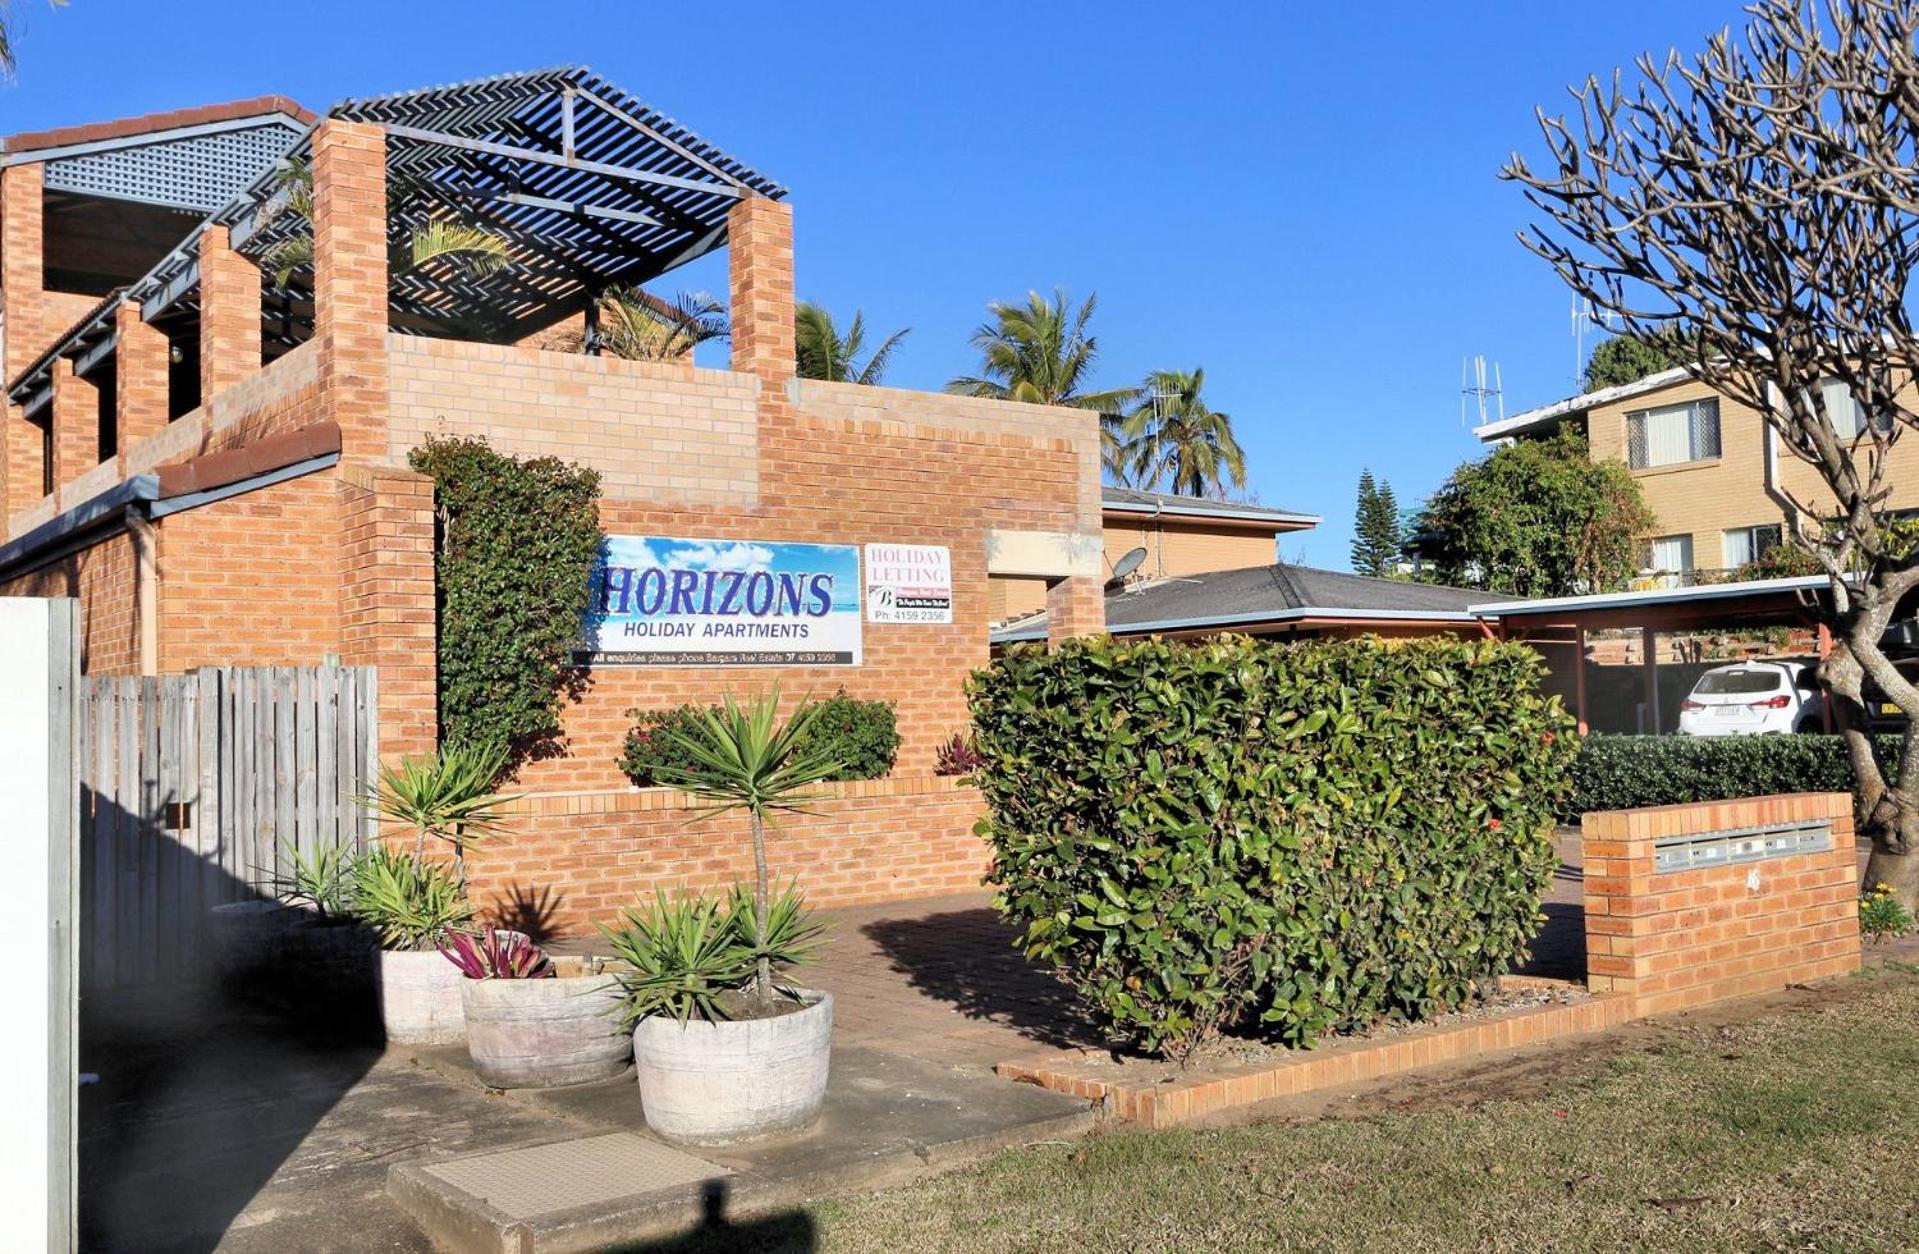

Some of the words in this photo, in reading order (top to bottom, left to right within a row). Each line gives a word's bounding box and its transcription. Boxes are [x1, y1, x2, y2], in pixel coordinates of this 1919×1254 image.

[871, 548, 944, 564] HOLIDAY
[873, 567, 945, 582] LETTING
[597, 566, 836, 618] HORIZONS
[894, 610, 918, 620] 4159
[921, 611, 945, 621] 2356
[624, 622, 696, 638] HOLIDAY
[702, 622, 810, 639] APARTMENTS
[593, 653, 605, 663] All
[607, 653, 646, 664] enquiries
